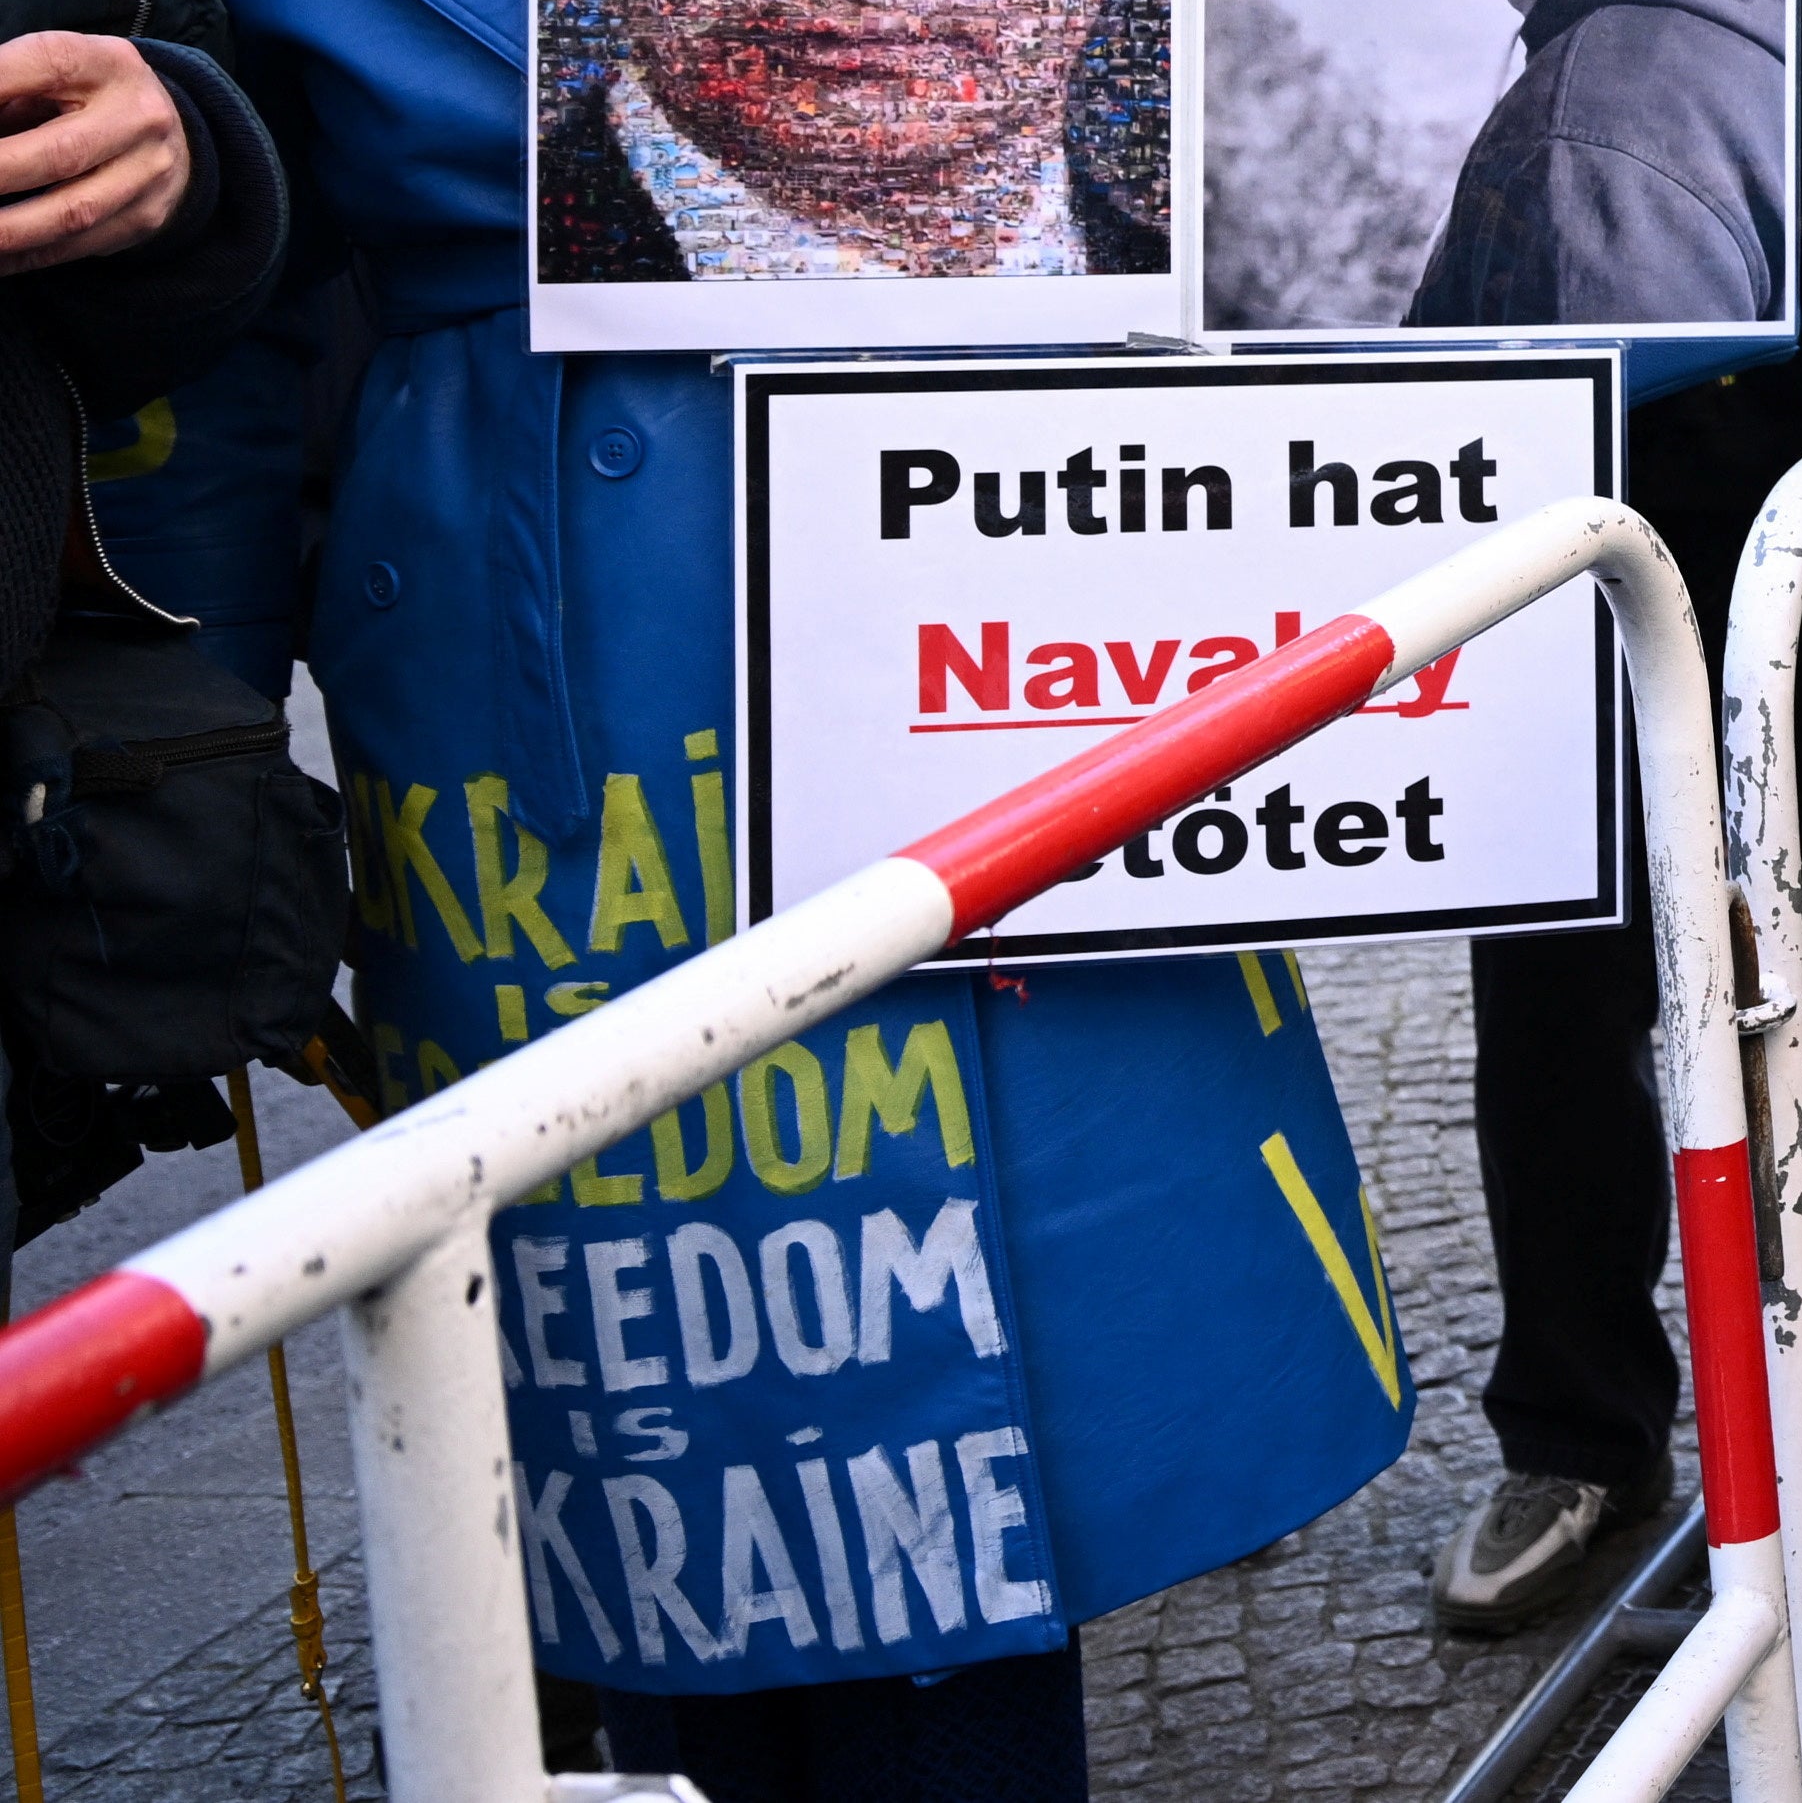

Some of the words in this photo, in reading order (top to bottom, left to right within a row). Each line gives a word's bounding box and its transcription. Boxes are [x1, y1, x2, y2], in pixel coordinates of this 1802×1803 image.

[879, 444, 1234, 540] Putin
[1288, 436, 1499, 528] hat
[917, 611, 1463, 718] Navay
[500, 1196, 1010, 1395] EEDOM
[569, 1406, 690, 1461] IS
[513, 1425, 1053, 1666] KRAINE
